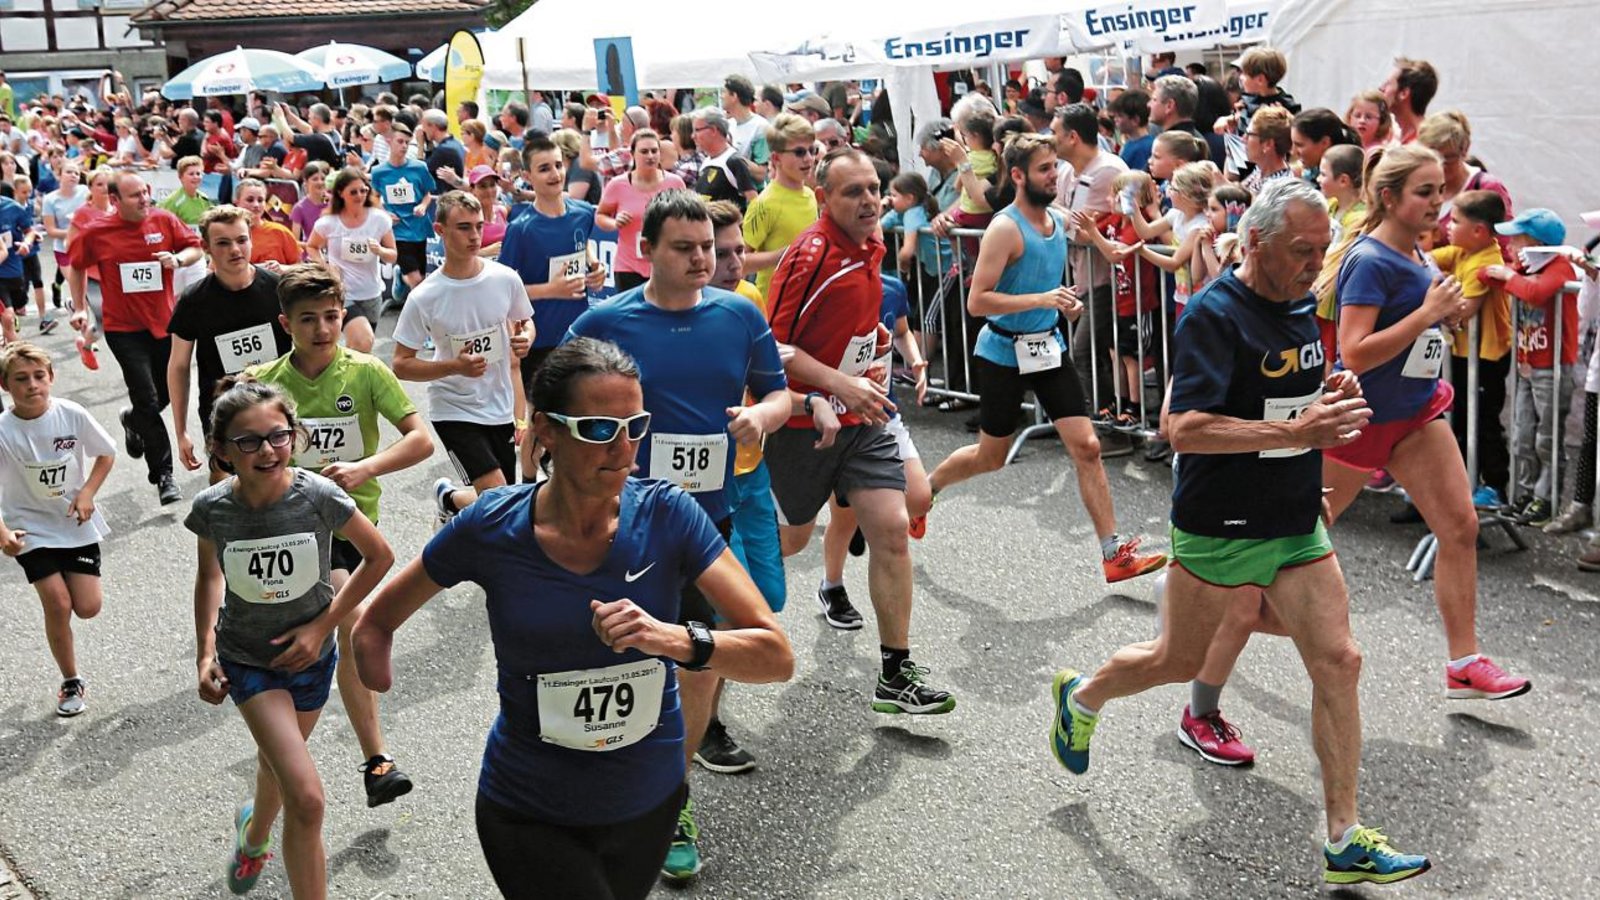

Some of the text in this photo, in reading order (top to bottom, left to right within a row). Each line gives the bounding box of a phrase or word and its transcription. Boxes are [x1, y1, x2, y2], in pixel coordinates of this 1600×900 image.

[1086, 6, 1196, 36] Ensinger
[884, 29, 1031, 58] Ensinger
[202, 85, 241, 94] Ensinger
[333, 75, 371, 85] Ensinger
[349, 244, 367, 254] 583
[132, 268, 152, 281] 475
[232, 335, 262, 357] 556
[311, 428, 345, 450] 472
[672, 447, 710, 471] 518
[39, 465, 67, 486] 477
[248, 549, 294, 580] 470
[275, 590, 290, 599] GLS
[588, 676, 620, 685] Laufcup
[621, 667, 659, 681] 13.05.2017
[573, 682, 635, 723] 479
[583, 720, 627, 733] Susanne
[605, 734, 625, 745] GLS
